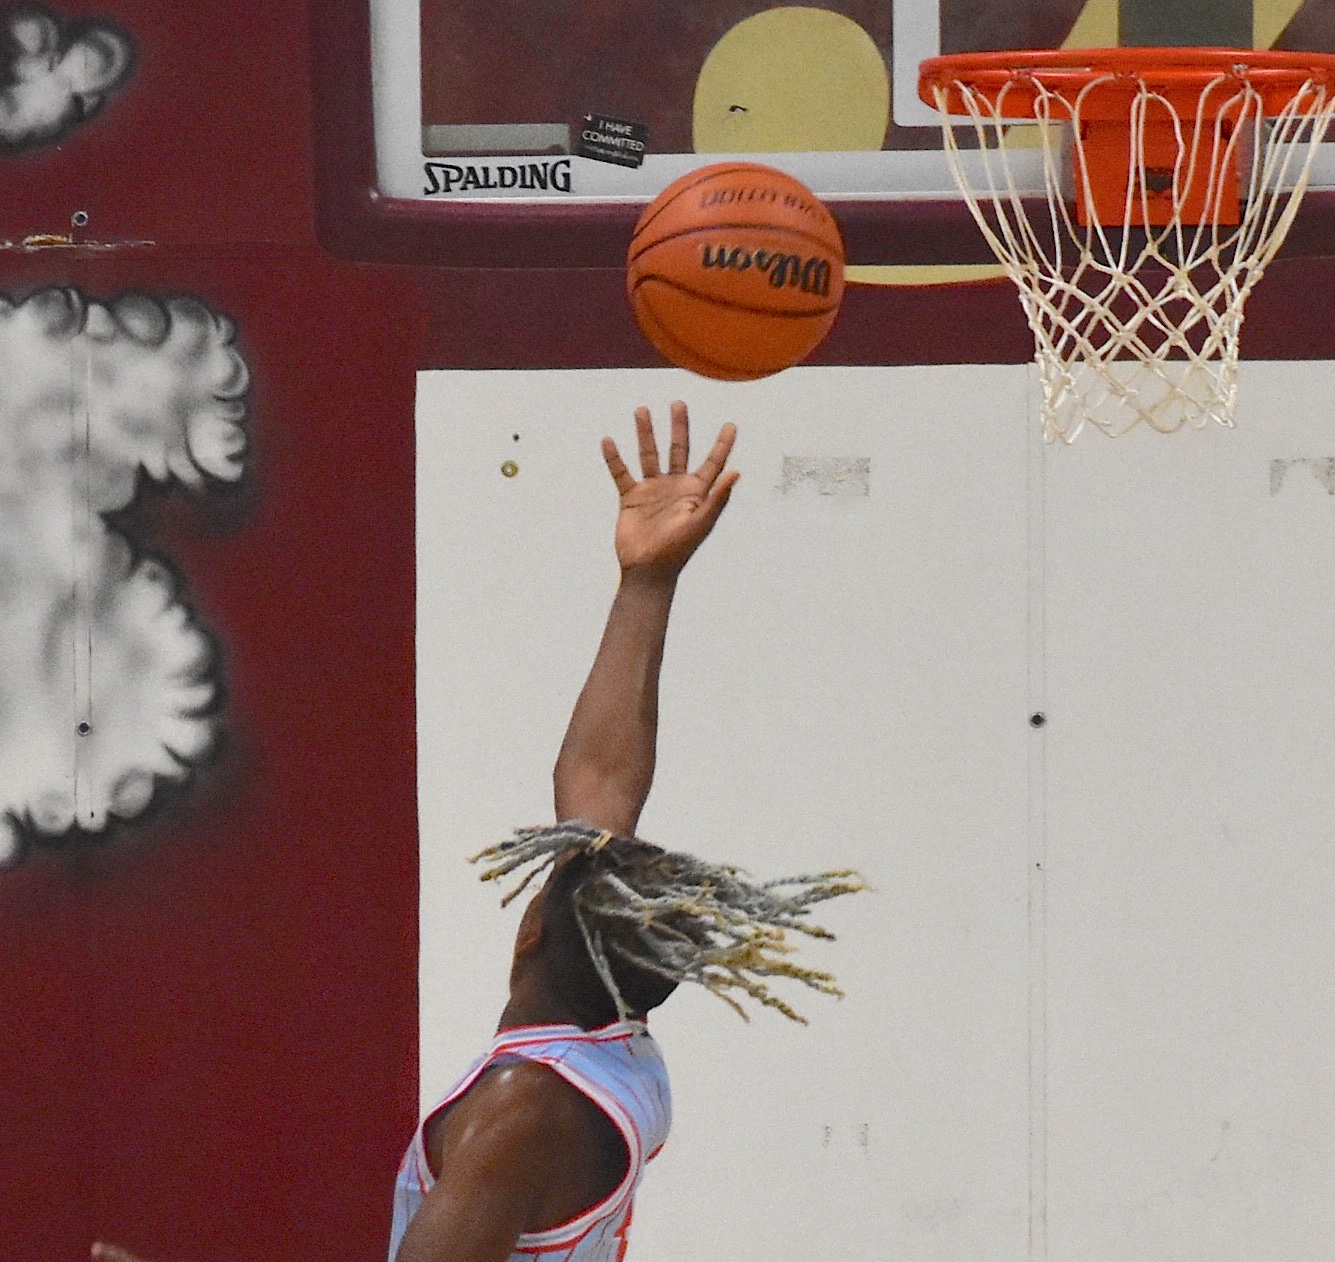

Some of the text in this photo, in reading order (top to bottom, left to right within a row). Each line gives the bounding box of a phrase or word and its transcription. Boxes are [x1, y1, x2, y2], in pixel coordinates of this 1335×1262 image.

[582, 130, 645, 152] COMMITTED
[605, 121, 633, 136] HAVE
[424, 160, 571, 195] SPALDING
[699, 244, 832, 297] Wilson
